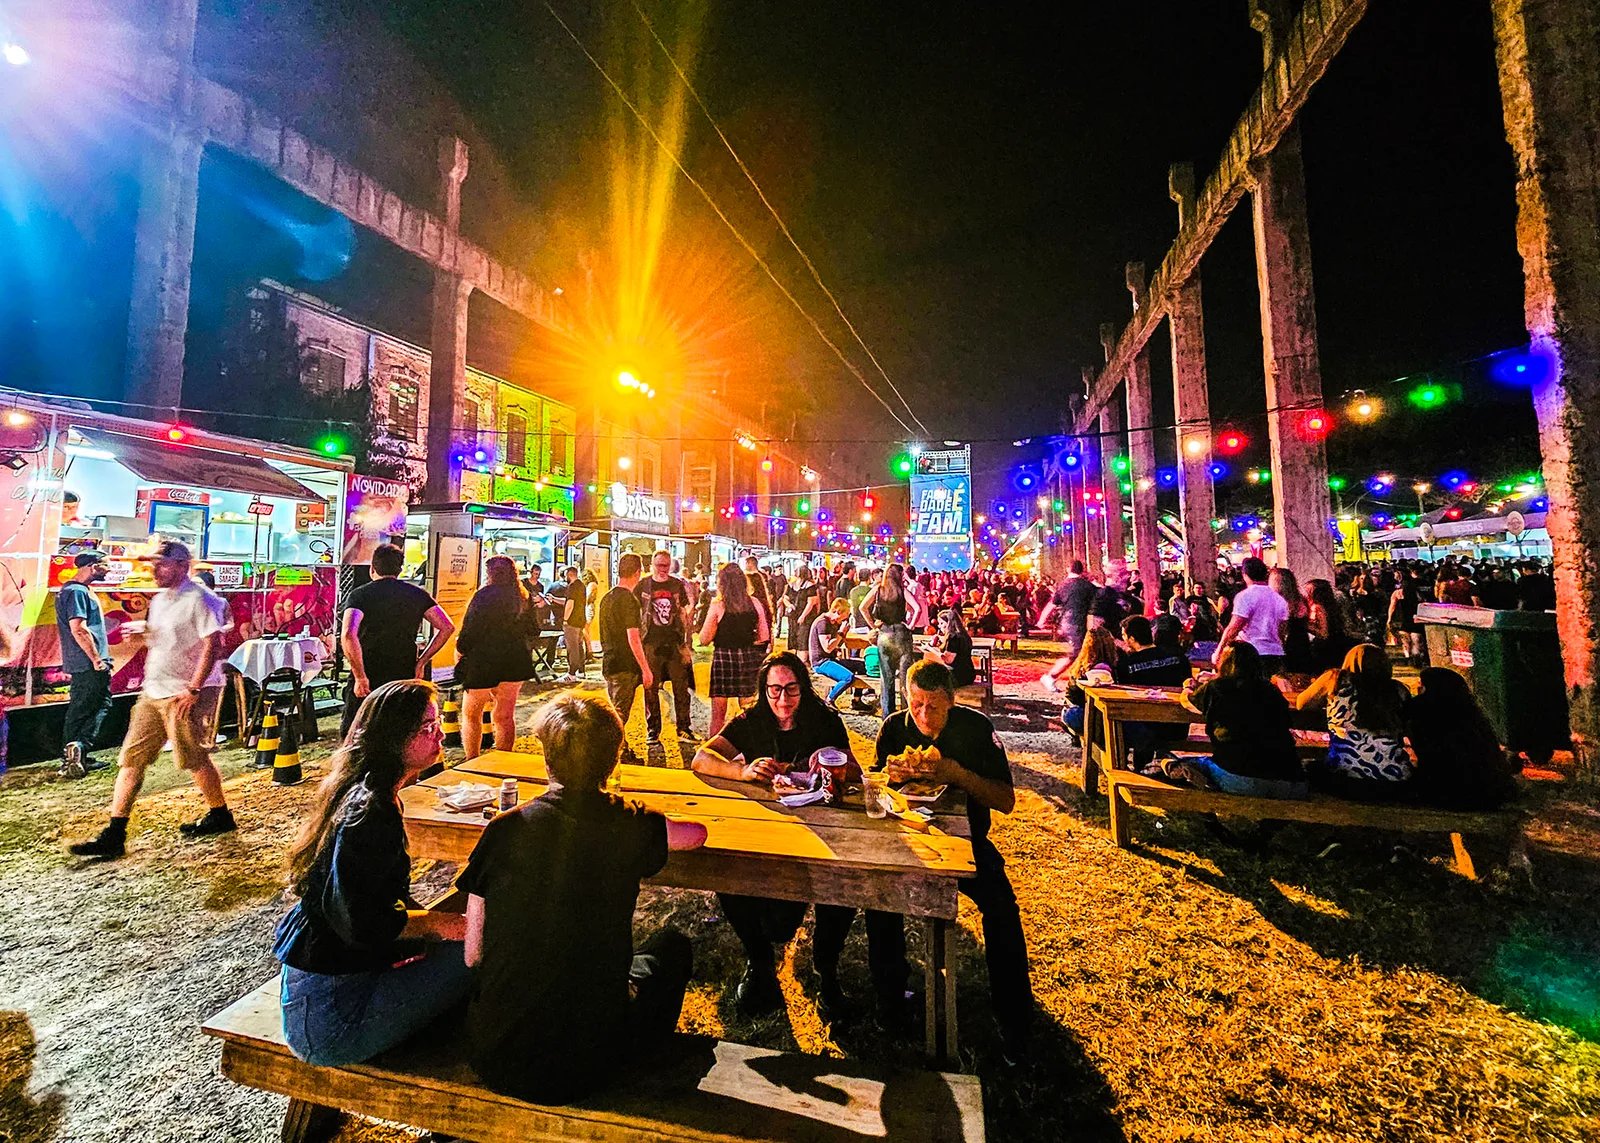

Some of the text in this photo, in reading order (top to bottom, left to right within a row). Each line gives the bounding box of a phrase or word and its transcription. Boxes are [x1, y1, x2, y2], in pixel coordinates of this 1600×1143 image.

[352, 478, 407, 498] NOVIDAD
[627, 494, 669, 524] PASTEL
[920, 500, 952, 511] DADE
[219, 567, 239, 575] LANCHE
[219, 575, 239, 583] SMASH
